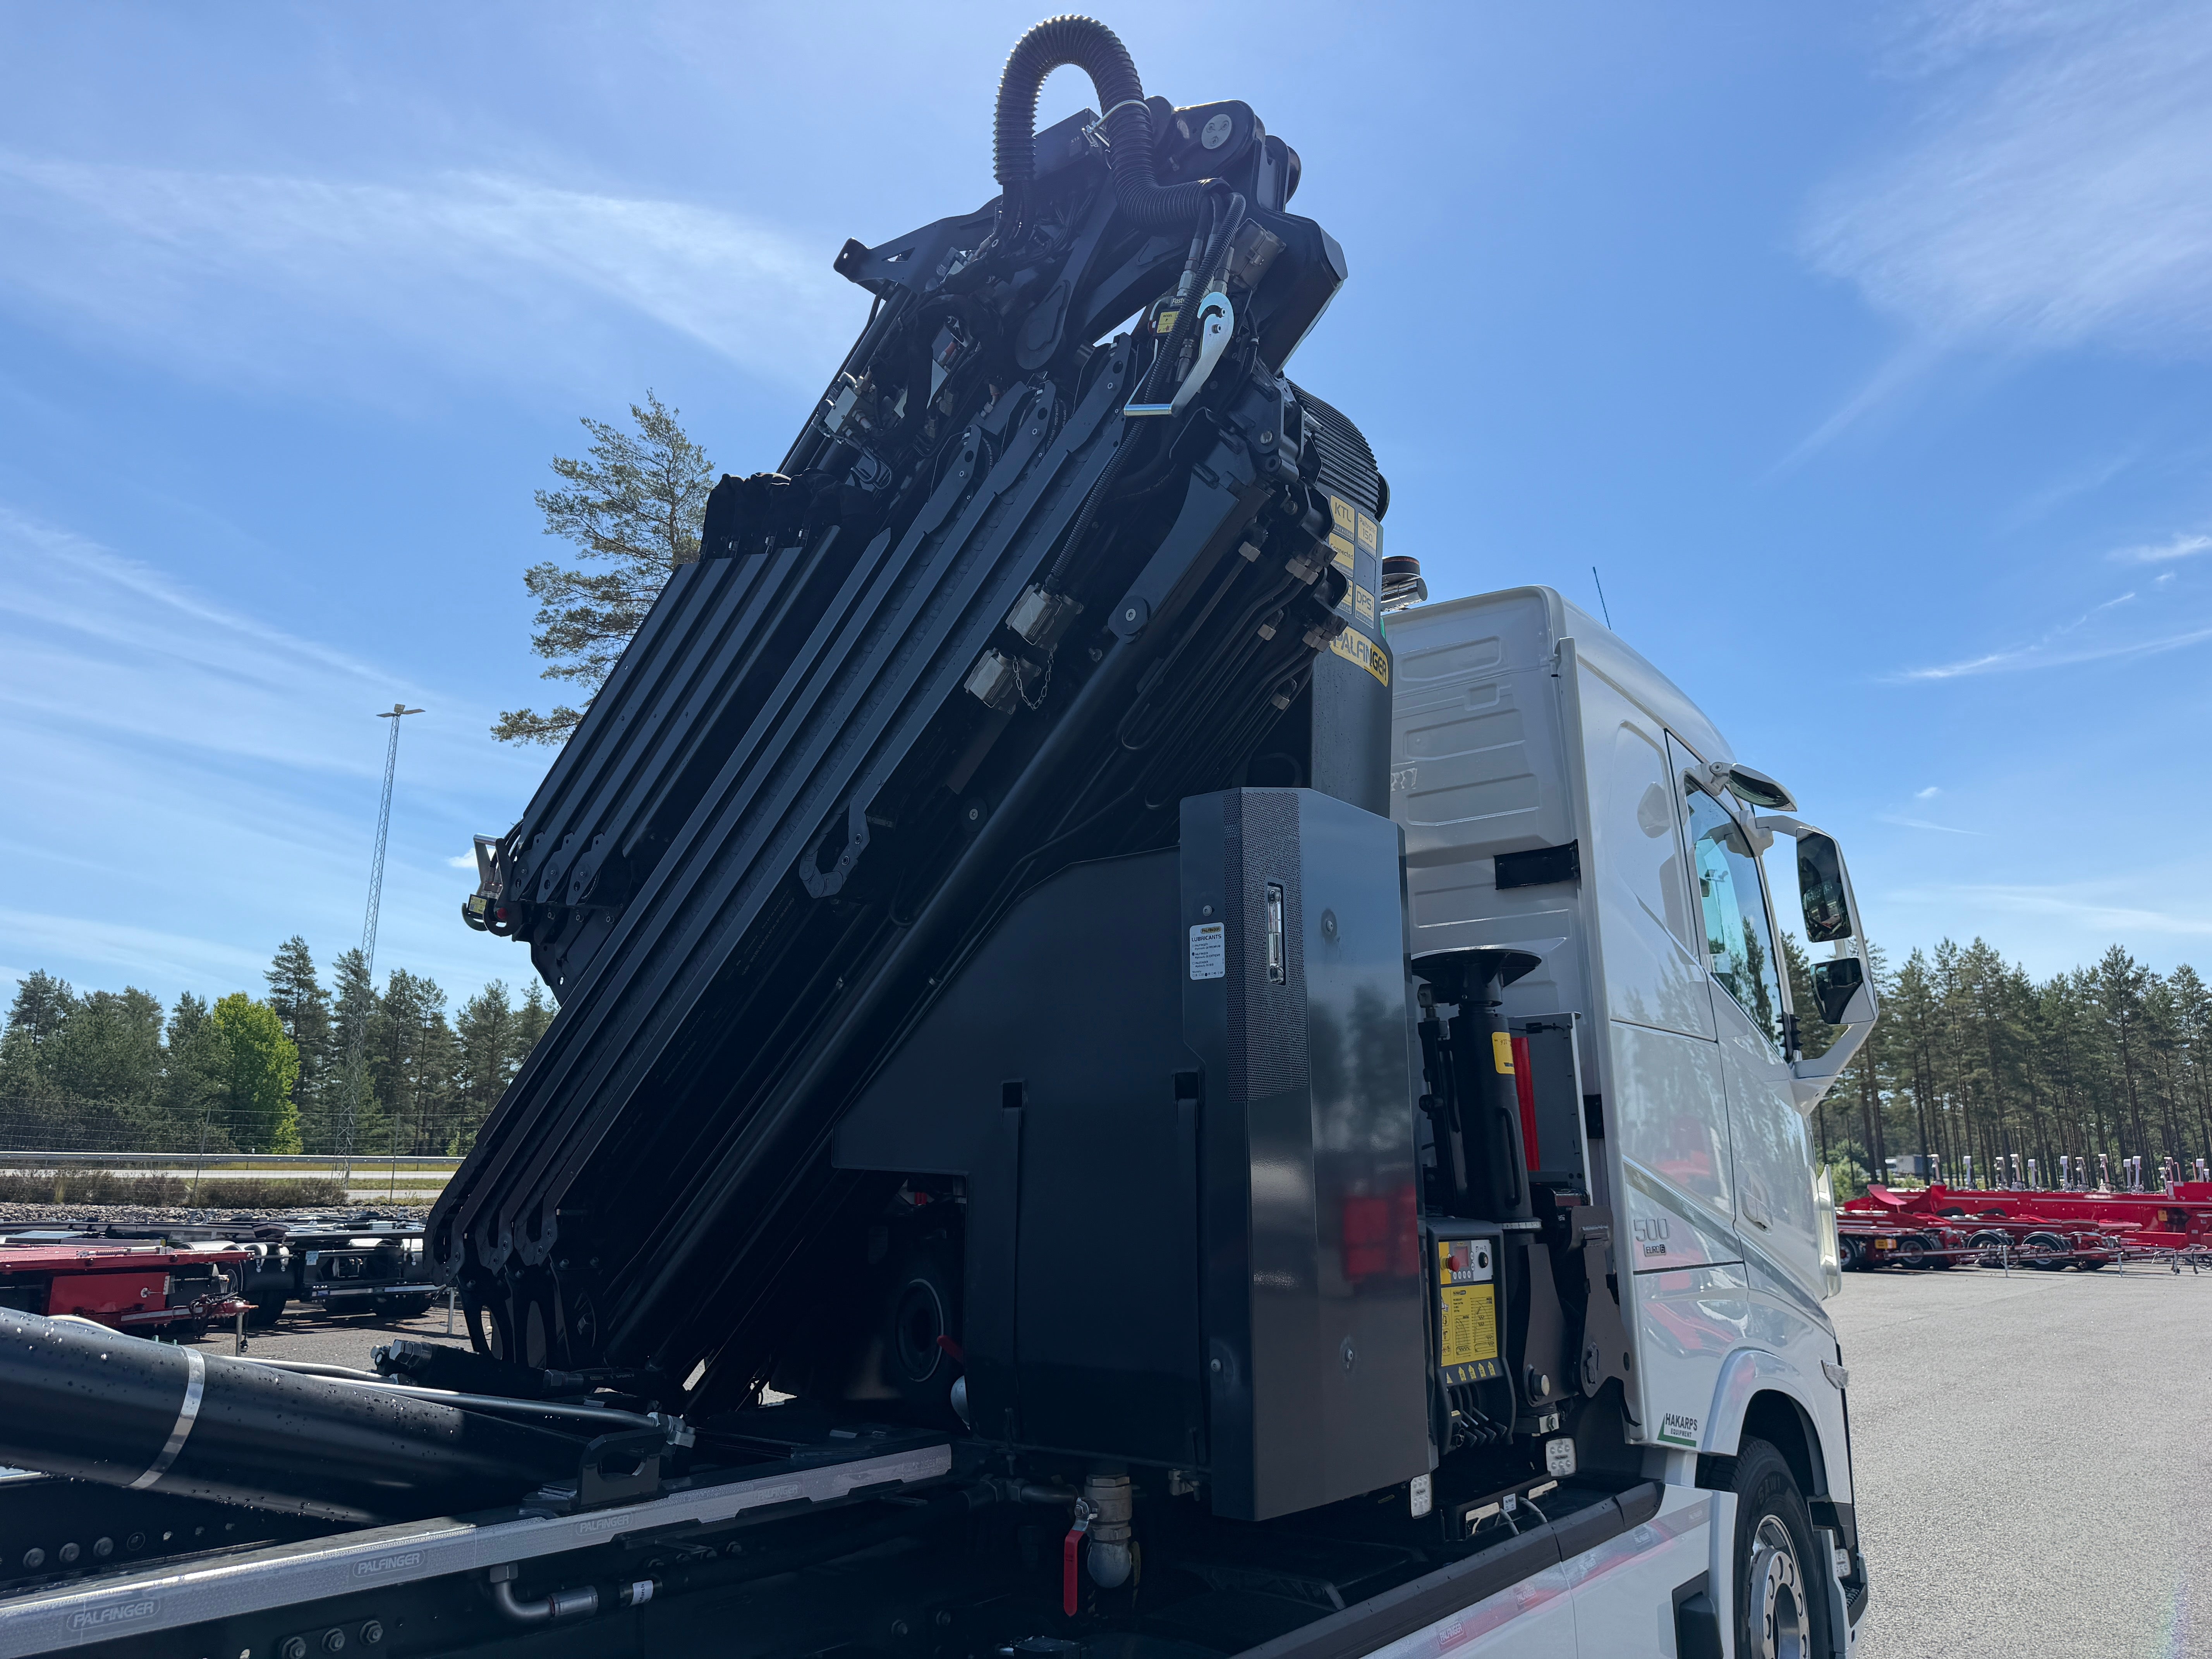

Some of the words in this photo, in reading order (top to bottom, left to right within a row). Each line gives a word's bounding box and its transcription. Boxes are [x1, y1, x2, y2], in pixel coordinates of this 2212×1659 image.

[1334, 502, 1351, 522] KTL
[1363, 528, 1373, 543] 150
[1357, 590, 1371, 611] DPS
[1333, 632, 1387, 681] PALFINGER
[1633, 1218, 1670, 1242] 500
[1666, 1413, 1697, 1431] HAKARPS
[1671, 1428, 1692, 1438] EQUIPMENT
[758, 1484, 799, 1502] PALFINGER
[580, 1514, 629, 1533] PALFINGER
[358, 1553, 420, 1575] PALFINGER
[73, 1601, 154, 1627] PALFINGER
